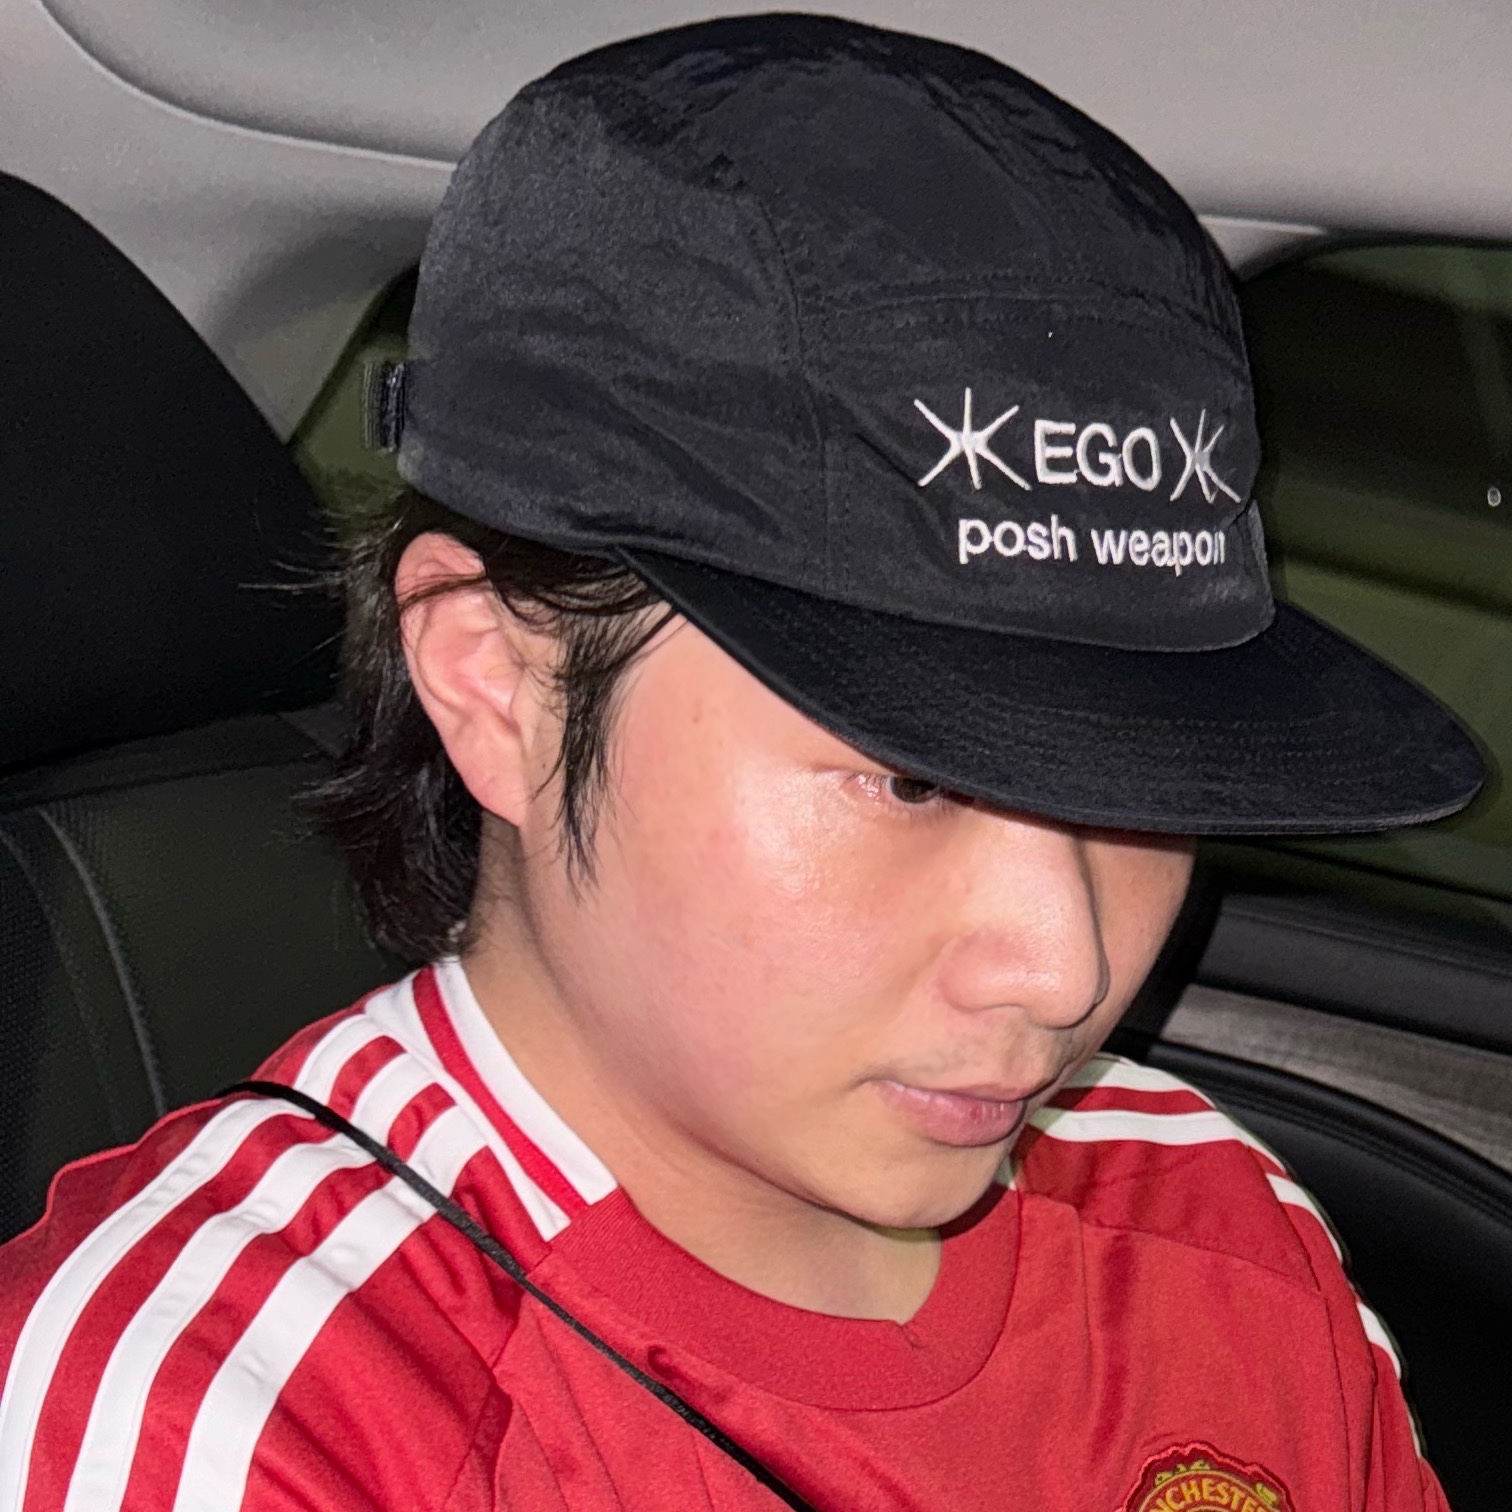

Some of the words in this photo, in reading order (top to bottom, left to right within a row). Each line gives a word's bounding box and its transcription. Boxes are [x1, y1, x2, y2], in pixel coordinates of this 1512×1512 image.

[1034, 418, 1161, 492] EGO
[958, 513, 1078, 565] posh
[1090, 528, 1226, 577] weapon
